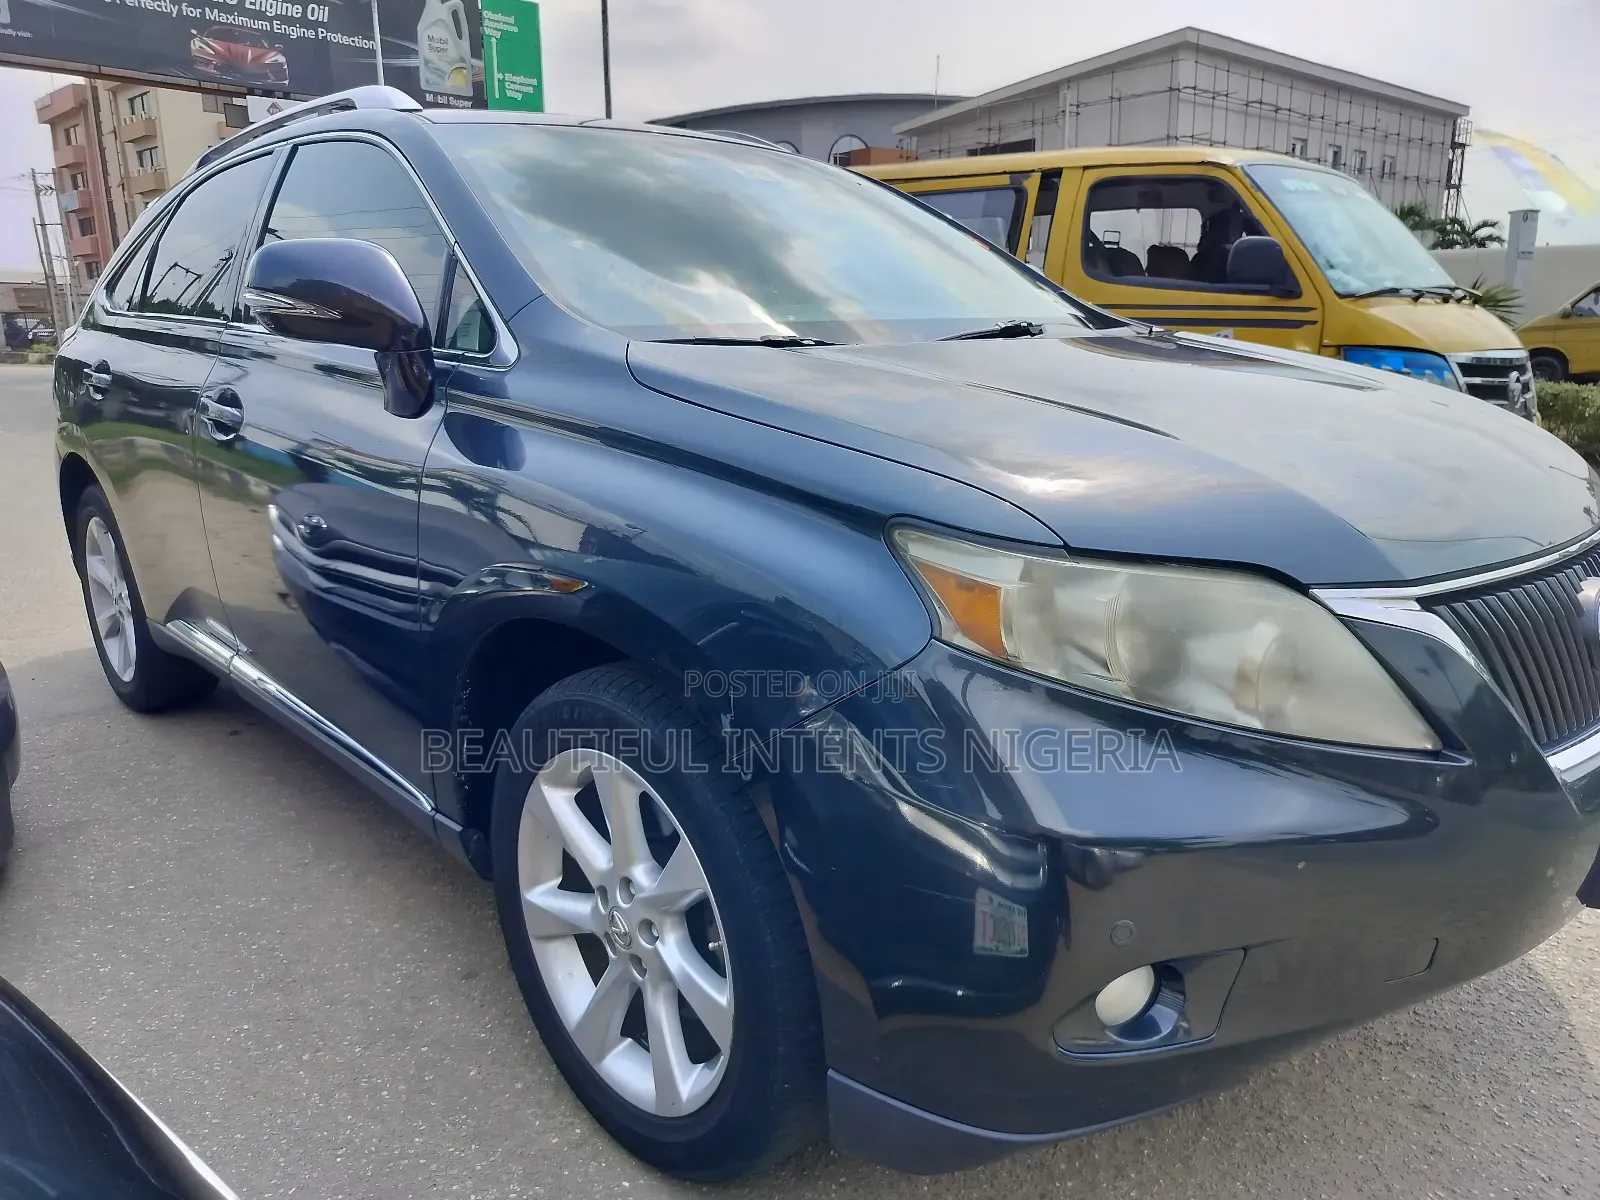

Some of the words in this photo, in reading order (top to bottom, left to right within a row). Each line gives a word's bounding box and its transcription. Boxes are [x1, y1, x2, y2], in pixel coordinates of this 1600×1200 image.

[307, 3, 329, 23] Oil
[181, 2, 202, 18] for
[205, 6, 271, 32] Maximum
[273, 20, 316, 39] Engine
[318, 28, 377, 50] Protection
[427, 34, 449, 46] Mobil
[428, 43, 449, 54] Super
[449, 96, 473, 108] Super
